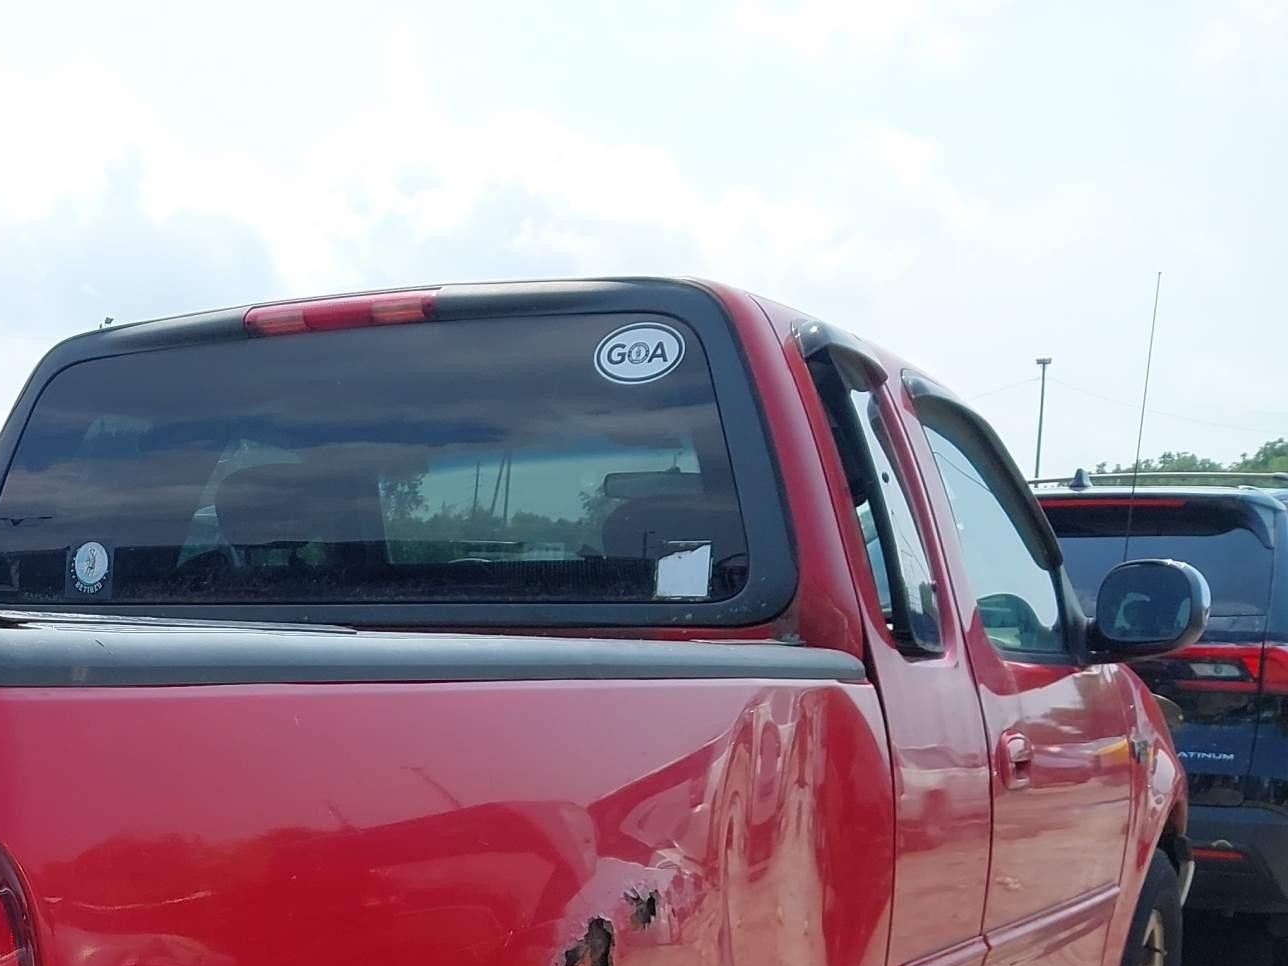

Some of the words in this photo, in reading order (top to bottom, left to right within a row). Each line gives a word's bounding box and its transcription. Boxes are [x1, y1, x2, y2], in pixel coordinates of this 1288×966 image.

[607, 341, 668, 366] GOA
[75, 581, 103, 594] RETIRED
[1177, 751, 1235, 760] ATINUM
